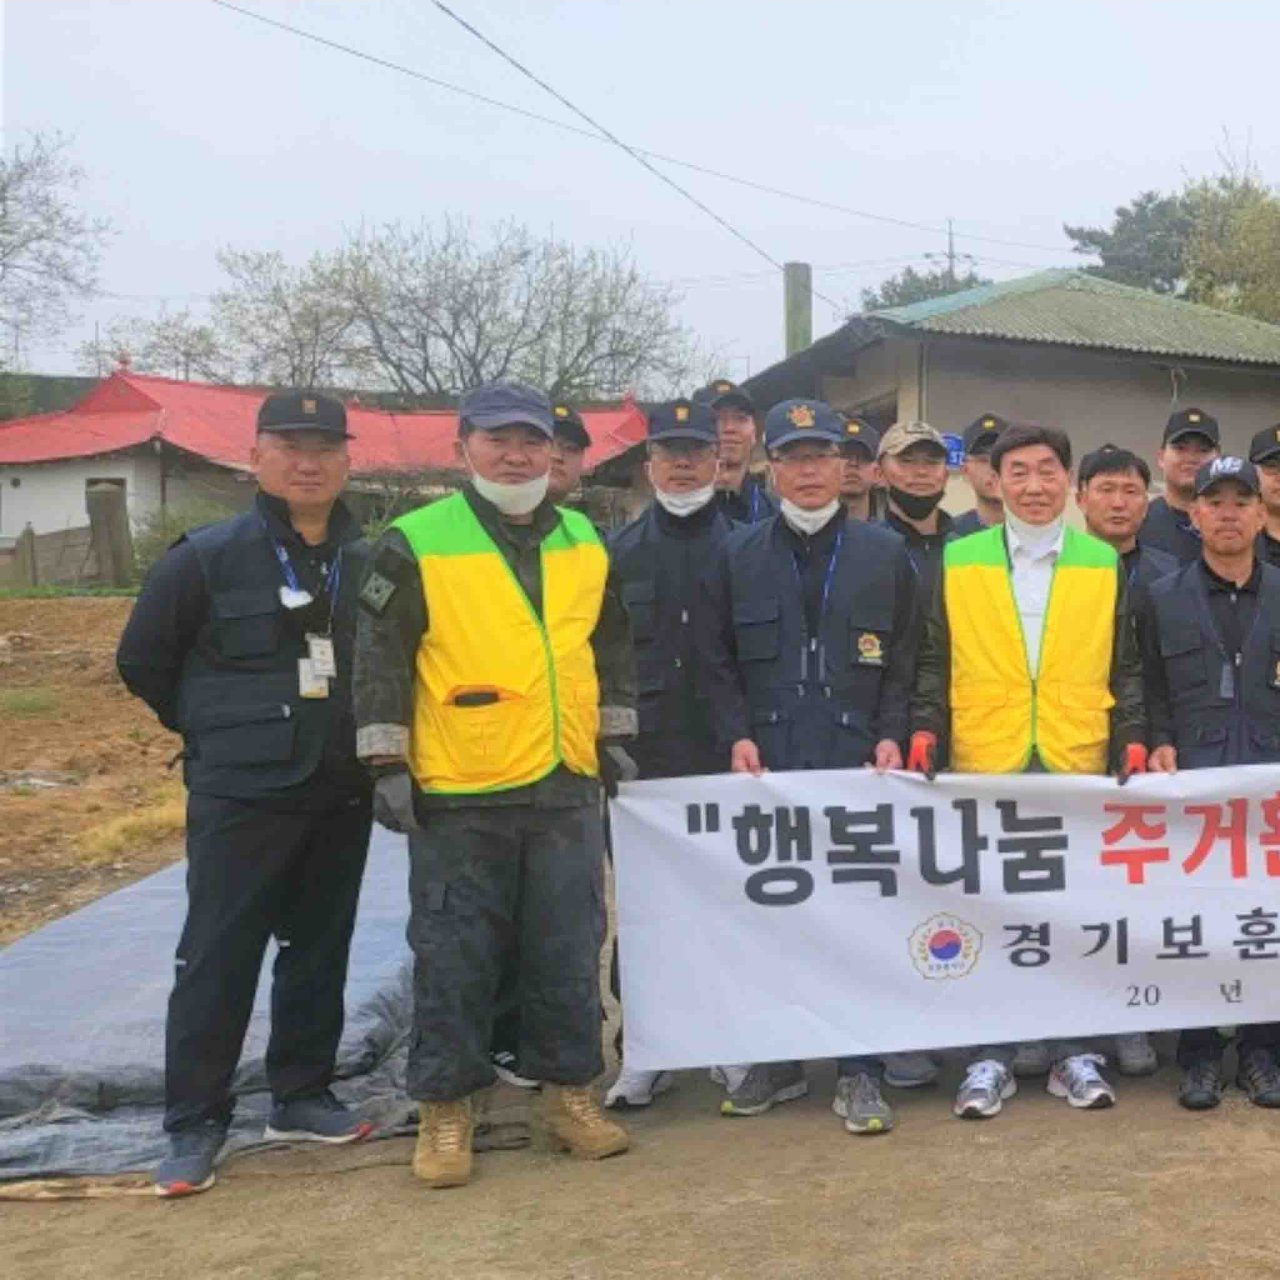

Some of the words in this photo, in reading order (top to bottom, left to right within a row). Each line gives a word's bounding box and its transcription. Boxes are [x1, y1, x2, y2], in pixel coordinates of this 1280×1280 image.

[685, 797, 1069, 907] "행복나눔
[1127, 984, 1161, 1007] 20
[1219, 979, 1244, 1004] 년
